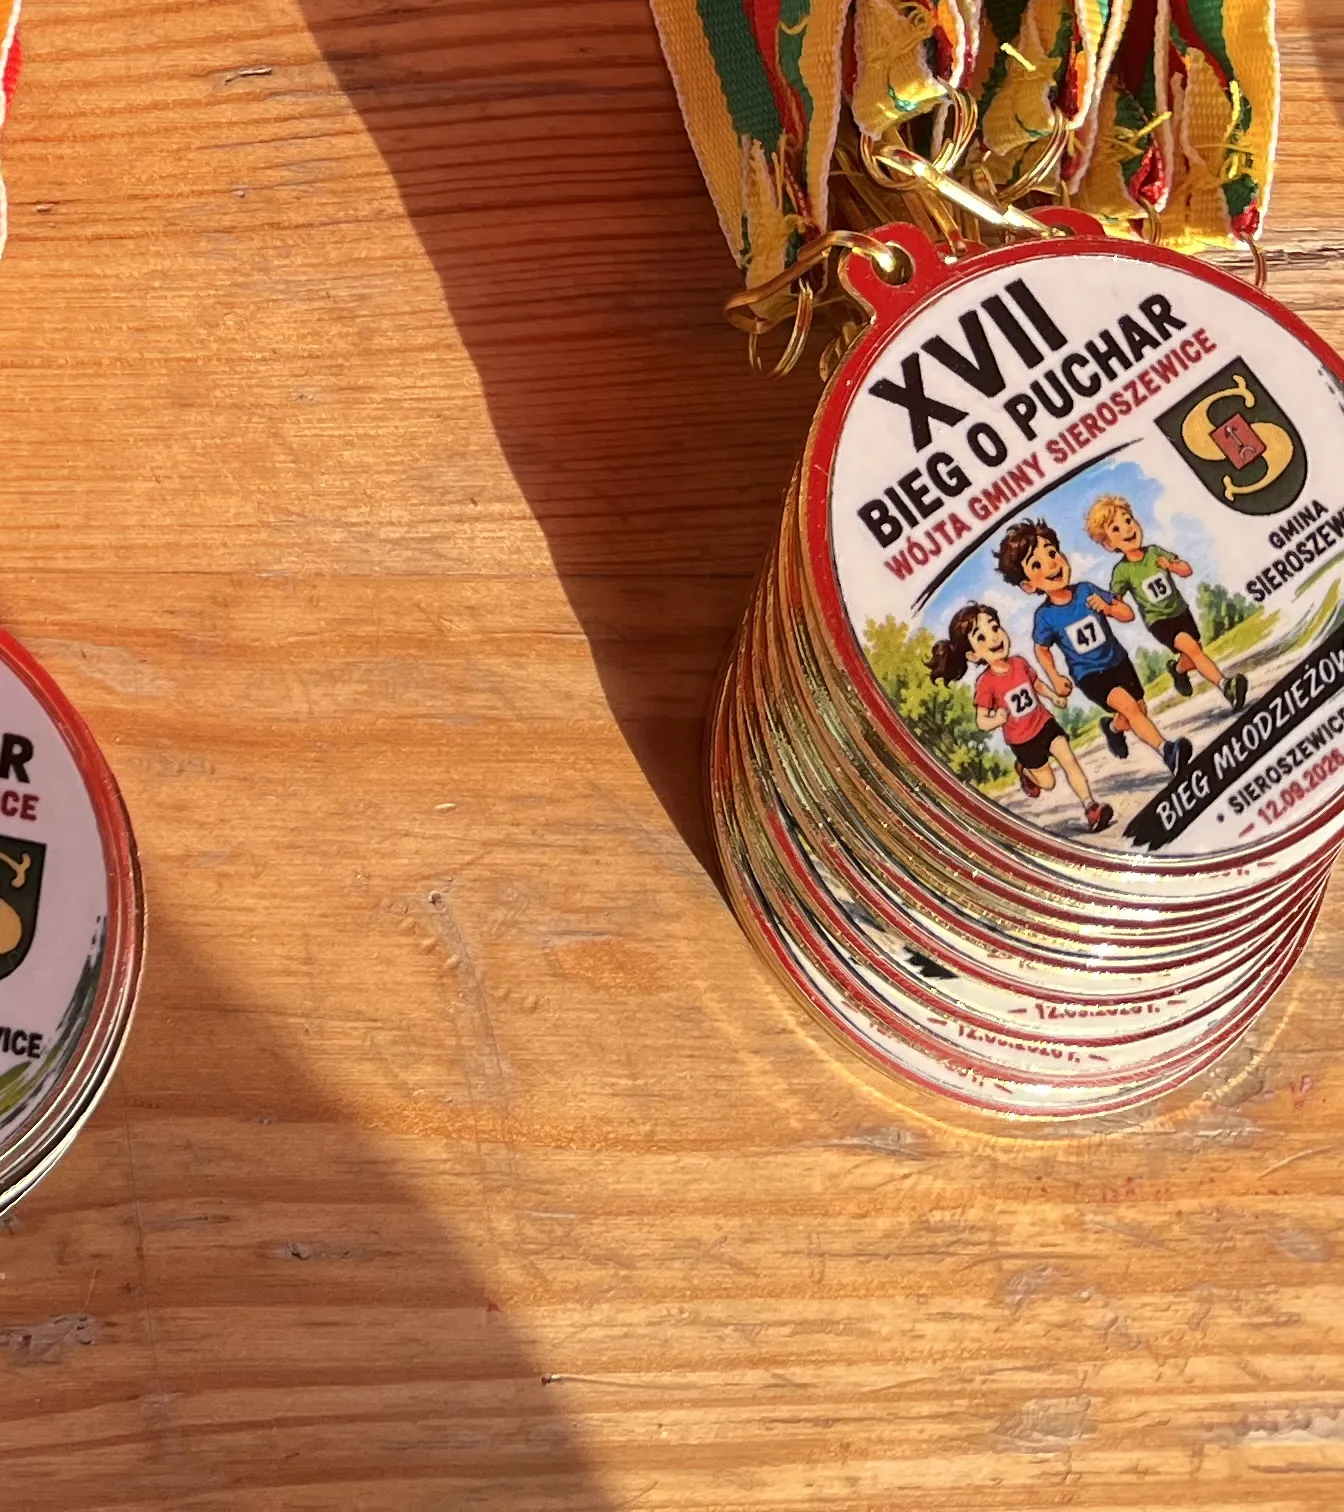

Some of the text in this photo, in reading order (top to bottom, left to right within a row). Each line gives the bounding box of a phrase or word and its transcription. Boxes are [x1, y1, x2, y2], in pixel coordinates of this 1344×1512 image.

[868, 277, 1068, 453] XVII
[857, 294, 1187, 549] BIEG O PUCHAR
[883, 327, 1217, 581] WÓJTA GMINY SIEROSZEWICE
[1245, 507, 1344, 603] SIEROSZEW
[1268, 499, 1329, 549] GMINA
[1148, 578, 1167, 599] 15
[1076, 622, 1097, 647] 47
[1011, 689, 1033, 714] 23
[1156, 769, 1211, 831] BIEG
